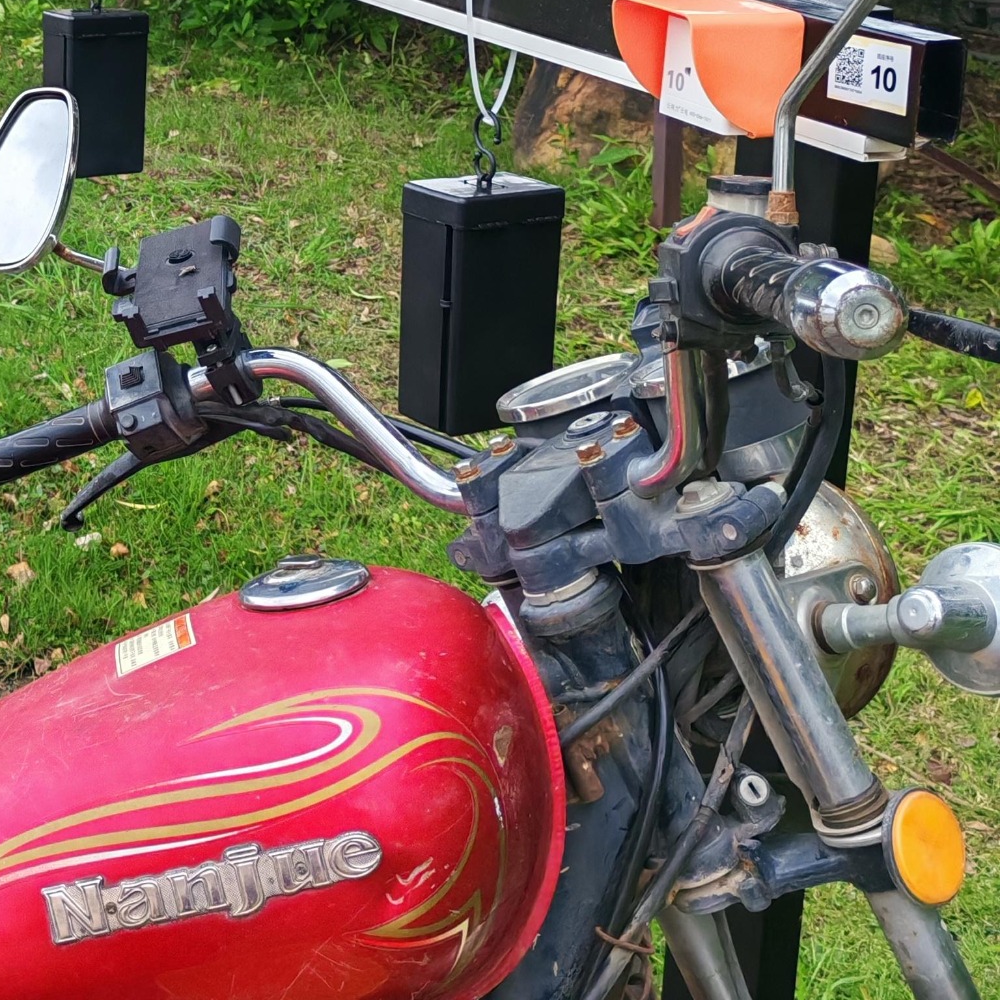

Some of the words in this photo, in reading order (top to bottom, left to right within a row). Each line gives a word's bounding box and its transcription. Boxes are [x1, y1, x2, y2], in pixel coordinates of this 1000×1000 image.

[668, 70, 685, 91] 10
[871, 65, 897, 93] 10
[42, 831, 383, 944] Nanjue
